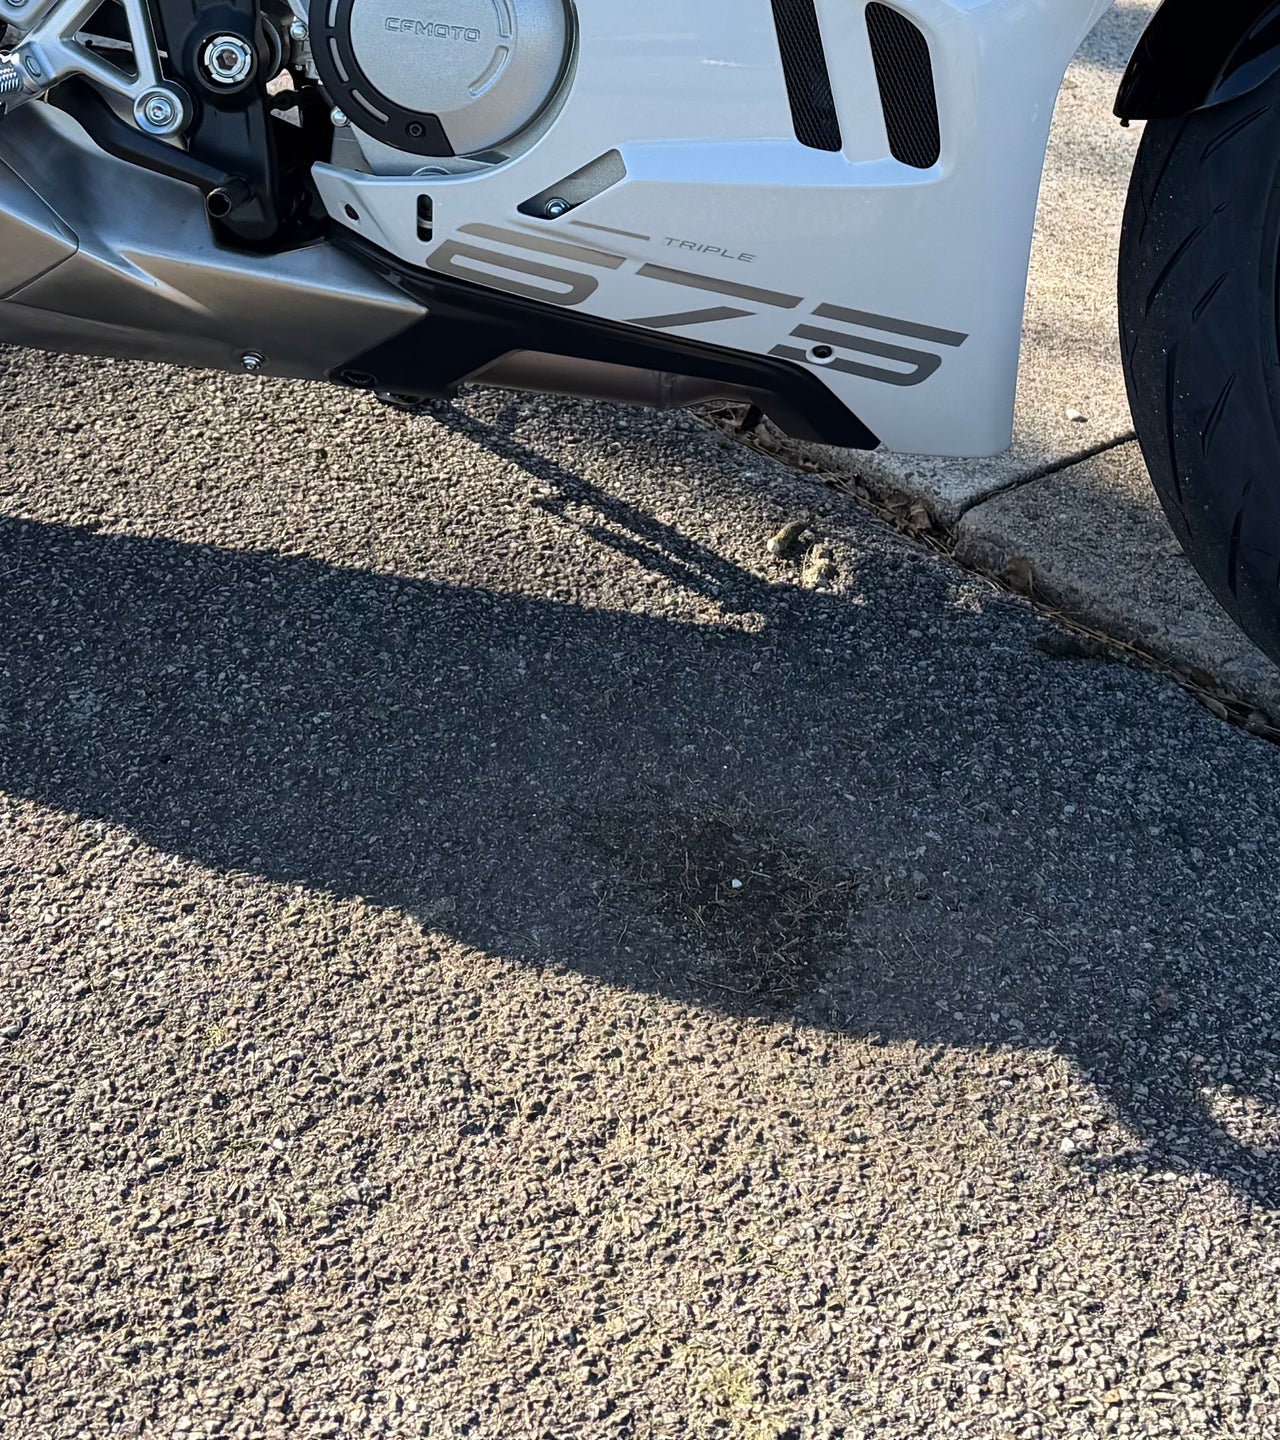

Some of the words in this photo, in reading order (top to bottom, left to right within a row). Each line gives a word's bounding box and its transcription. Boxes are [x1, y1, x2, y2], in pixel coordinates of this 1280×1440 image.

[385, 17, 481, 42] CFMOTO
[664, 236, 759, 263] TRIPLE
[426, 222, 970, 387] 675
